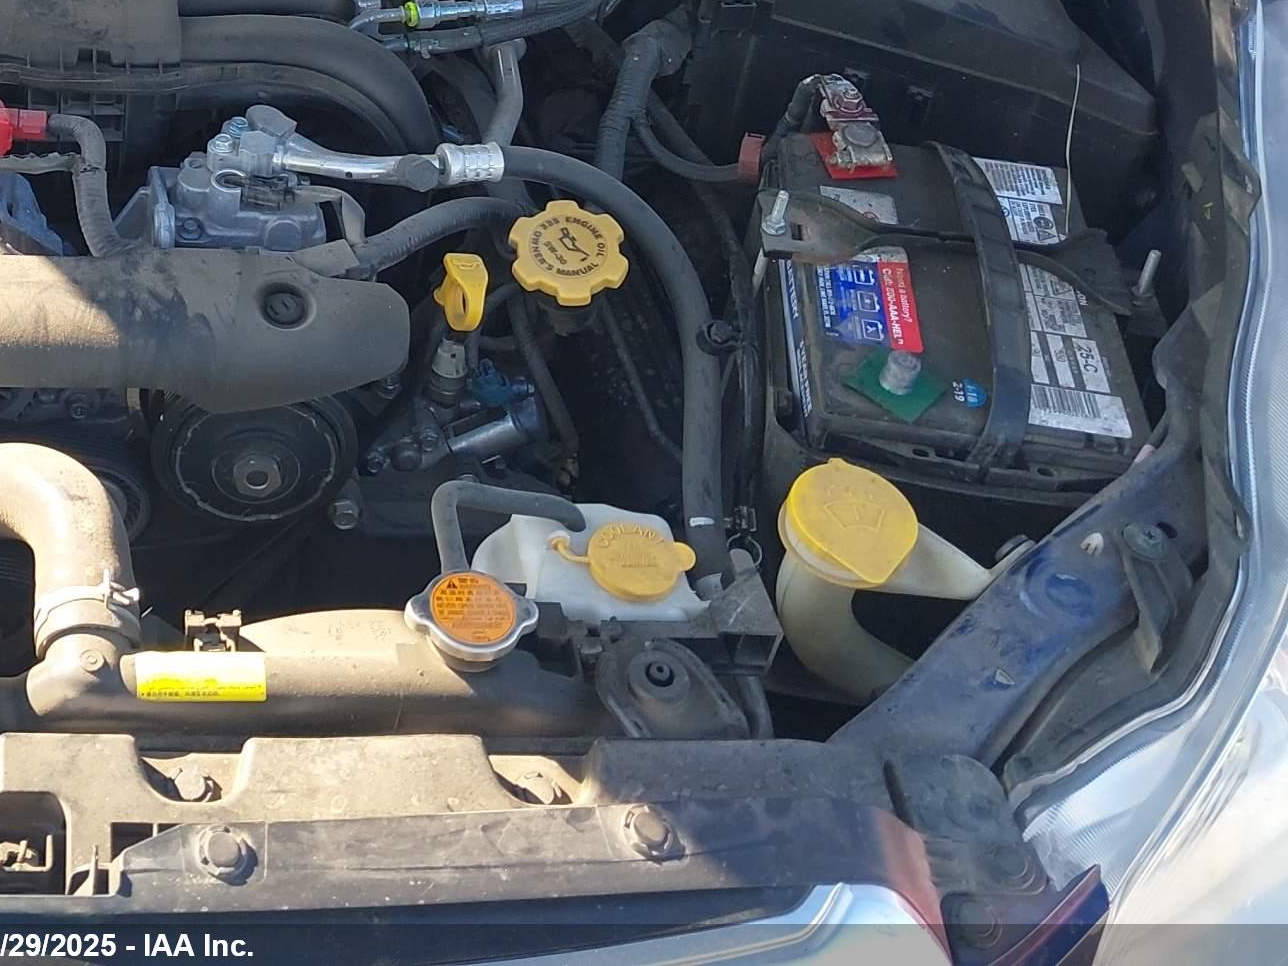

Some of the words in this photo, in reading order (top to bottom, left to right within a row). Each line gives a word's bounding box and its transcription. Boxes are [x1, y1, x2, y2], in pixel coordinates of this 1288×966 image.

[541, 217, 561, 231] SEE
[555, 261, 600, 276] MANUAL
[544, 240, 568, 265] 5W-30
[565, 216, 603, 240] ENGINE
[595, 241, 607, 260] OIL
[1077, 343, 1098, 373] 25-C
